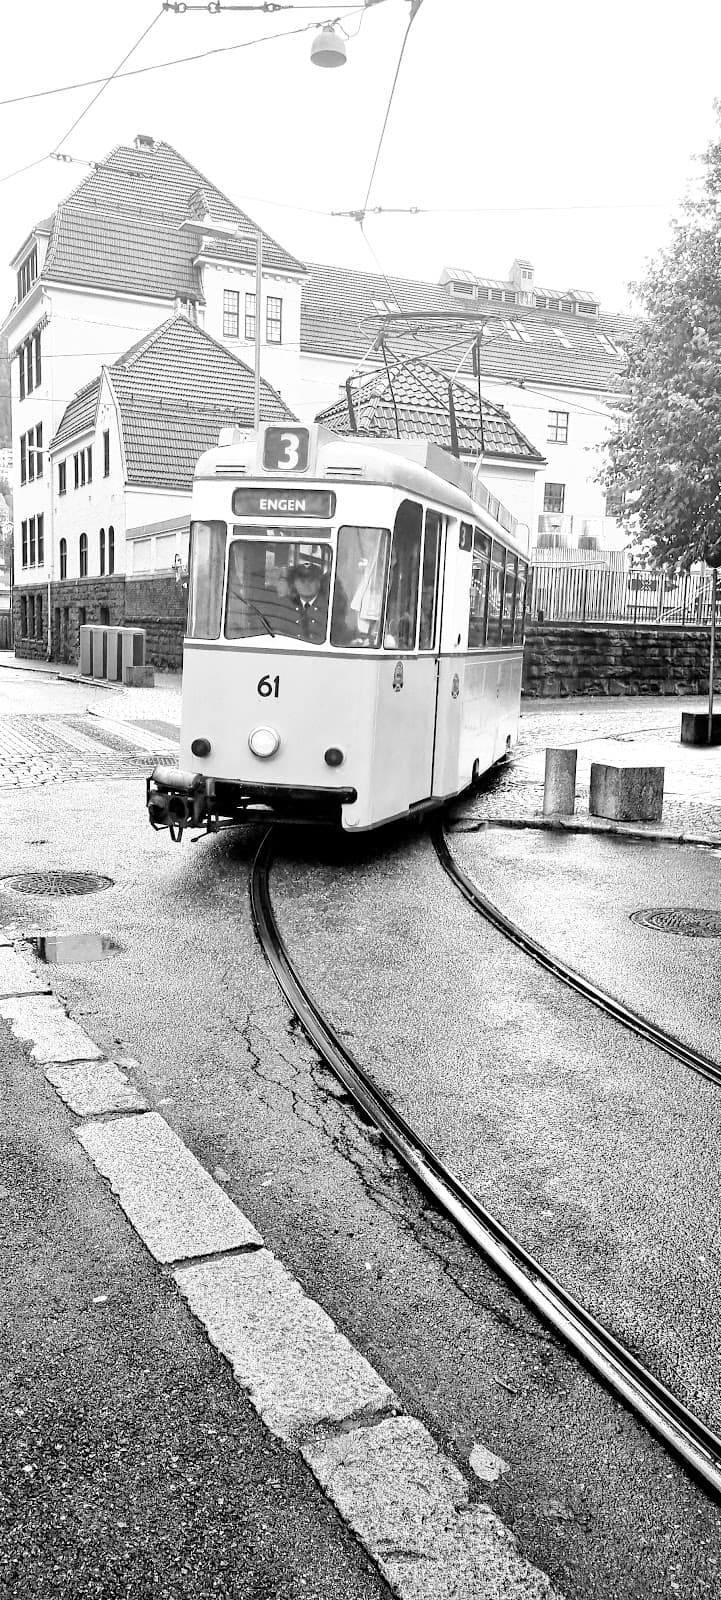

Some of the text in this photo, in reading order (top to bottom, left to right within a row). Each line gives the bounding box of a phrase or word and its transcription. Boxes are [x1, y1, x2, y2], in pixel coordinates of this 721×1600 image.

[277, 432, 300, 470] 3
[259, 498, 306, 512] ENGEN
[257, 674, 280, 698] 61
